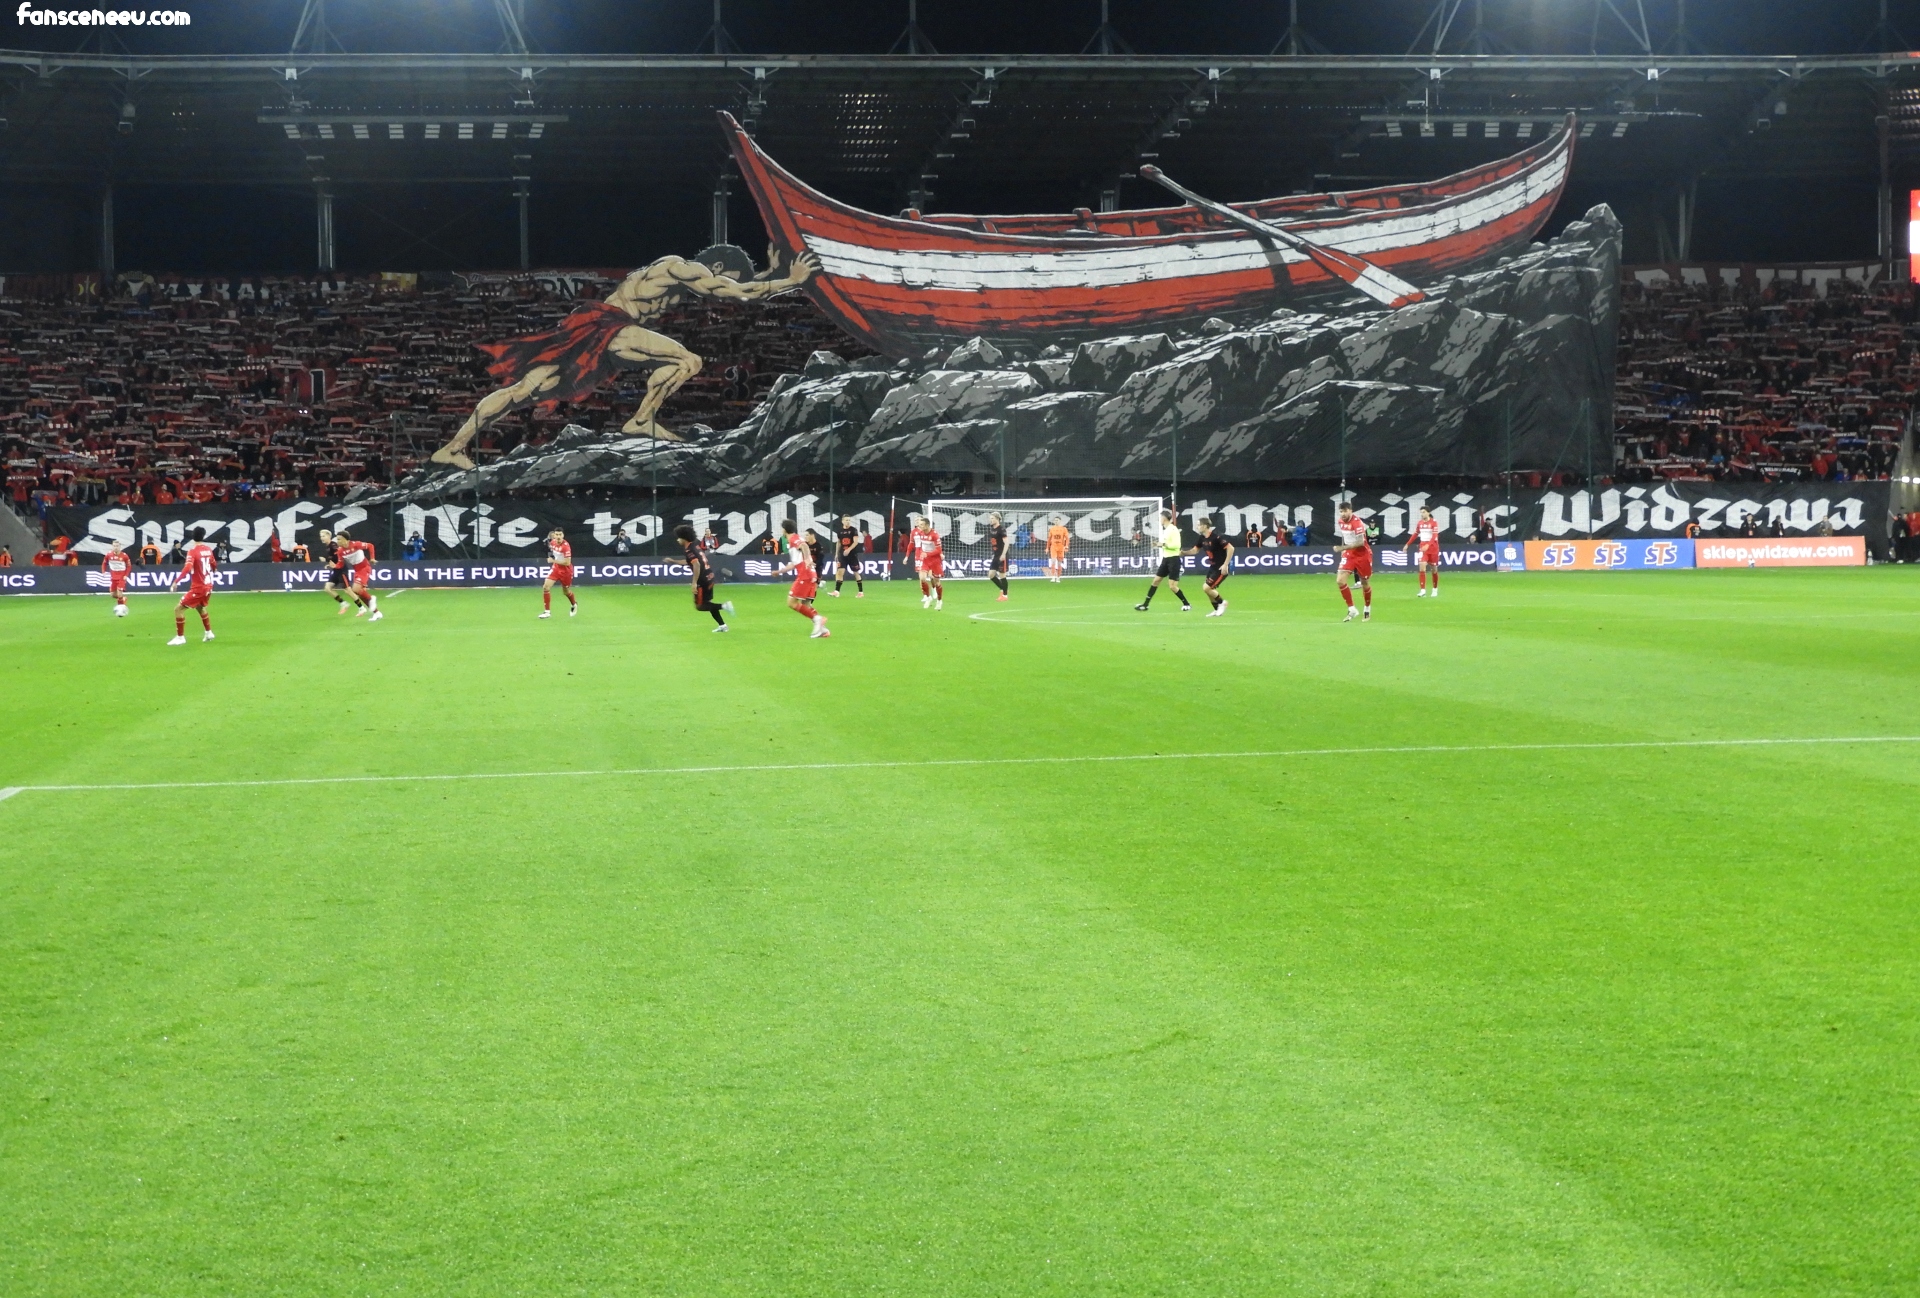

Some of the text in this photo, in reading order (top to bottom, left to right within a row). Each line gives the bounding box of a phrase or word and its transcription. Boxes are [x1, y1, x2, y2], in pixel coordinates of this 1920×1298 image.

[396, 501, 539, 549] Nie
[583, 511, 663, 546] to
[682, 493, 885, 556] tylko
[1330, 490, 1519, 539] kibic
[1536, 485, 1866, 536] Widzewa
[1074, 557, 1112, 569] THE
[1119, 556, 1196, 569] FUTE
[1234, 553, 1335, 567] LOGISTICS
[1542, 542, 1677, 567] STS STS STS
[1702, 544, 1854, 561] sklep.widzew.com
[127, 570, 239, 587] NEWPRT
[398, 568, 419, 580] IN
[424, 567, 465, 580] THE
[471, 566, 550, 580] FUTURE
[591, 563, 694, 578] LOGISTICS
